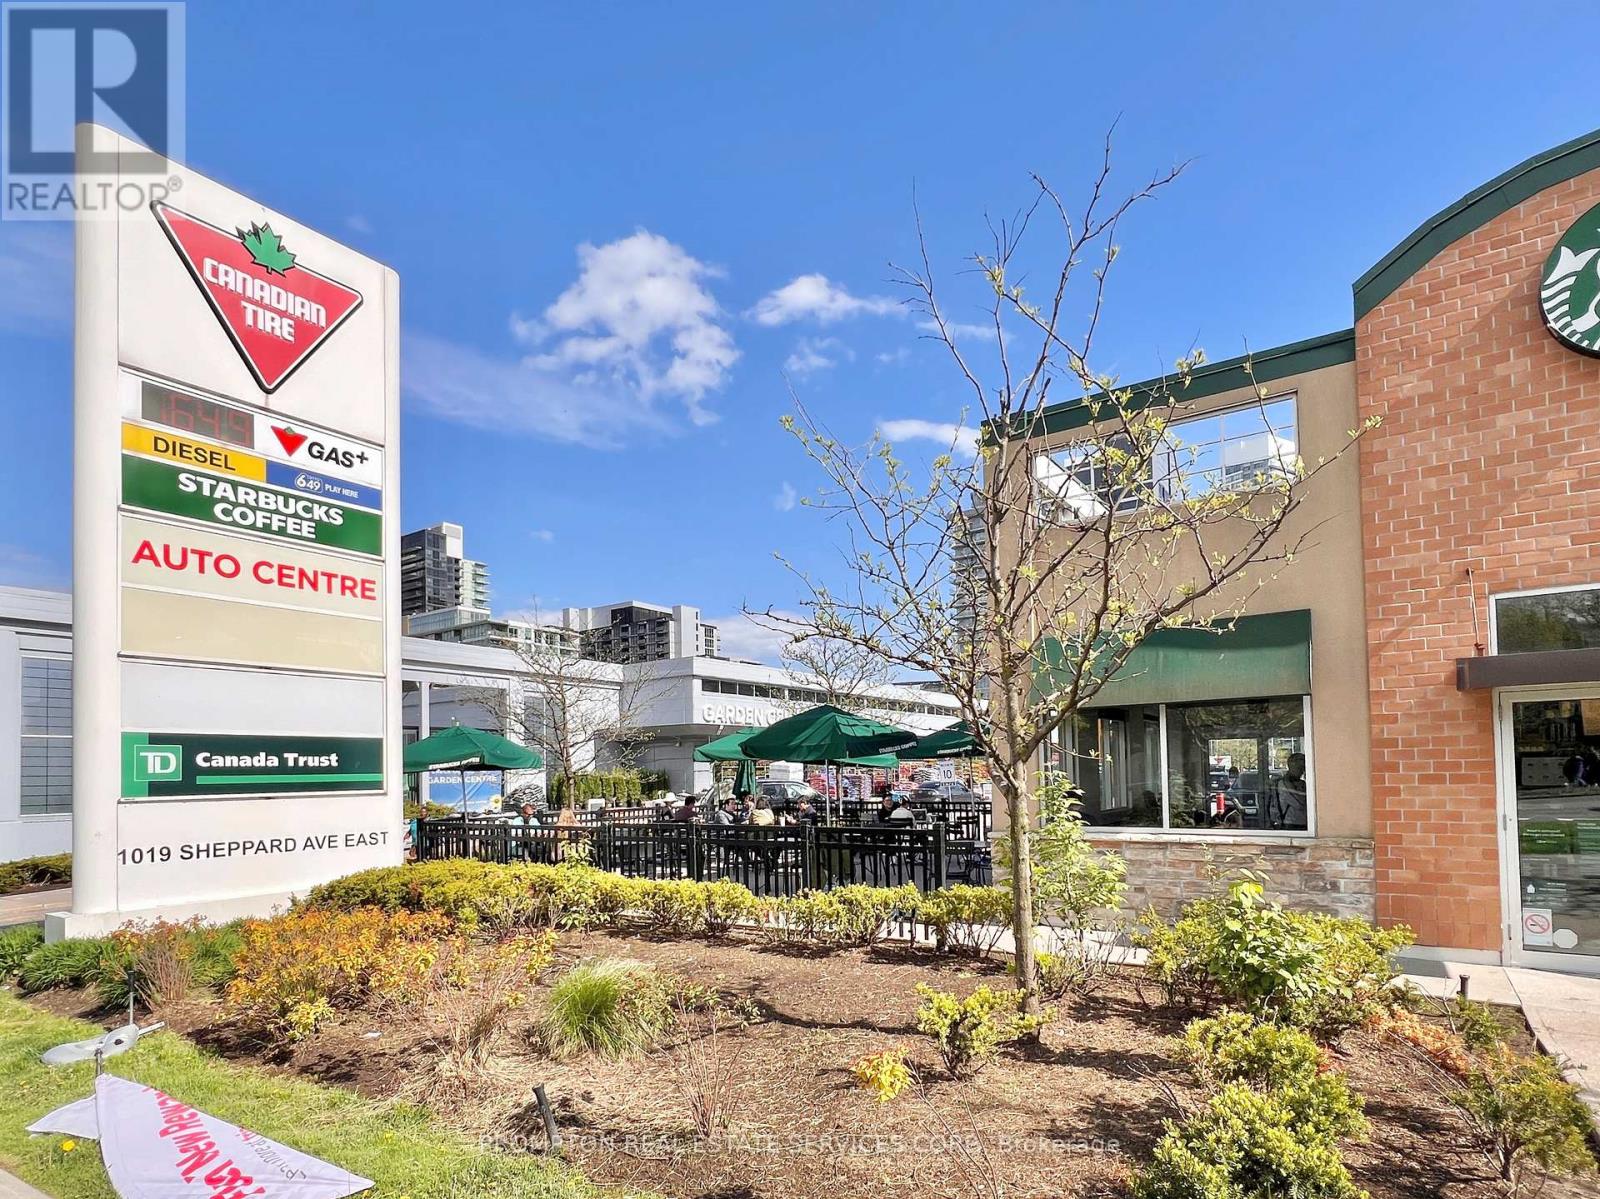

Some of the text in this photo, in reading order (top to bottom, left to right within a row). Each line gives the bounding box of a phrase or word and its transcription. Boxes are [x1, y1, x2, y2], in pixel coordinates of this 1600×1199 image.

[203, 257, 326, 329] CANADIAN
[241, 300, 294, 343] TIRE
[153, 436, 236, 471] DIESEL
[178, 472, 344, 526] STARBUCKS
[324, 484, 341, 494] PLAY
[342, 488, 359, 498] HERE
[213, 503, 316, 539] COFFEE
[131, 540, 377, 601] AUTO CENTRE
[703, 704, 763, 726] GARDEN
[139, 751, 339, 774] TD Canada Trust
[943, 769, 952, 779] 10
[428, 776, 463, 784] GARDEN
[117, 831, 390, 865] 1019 SHEPPARD AVE EAST
